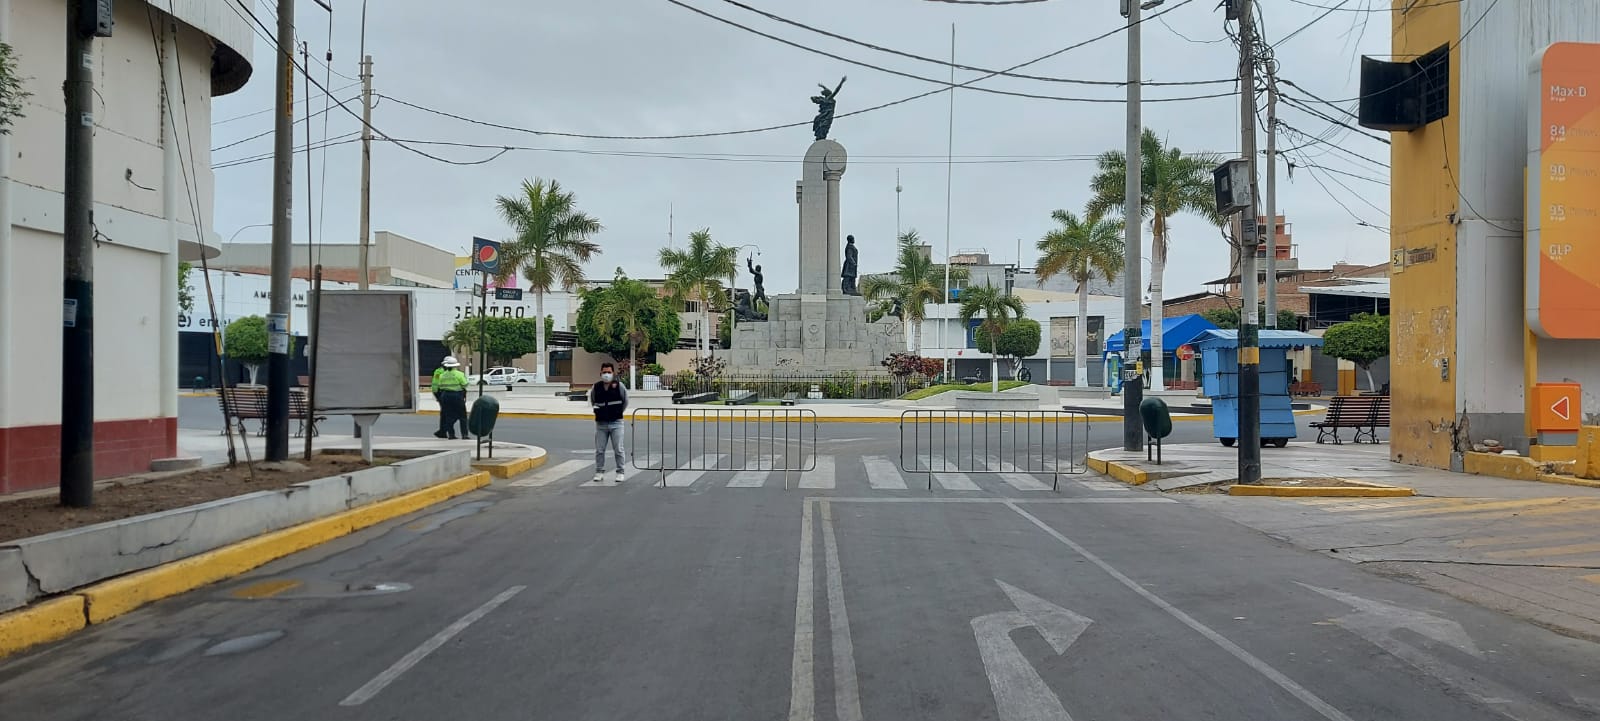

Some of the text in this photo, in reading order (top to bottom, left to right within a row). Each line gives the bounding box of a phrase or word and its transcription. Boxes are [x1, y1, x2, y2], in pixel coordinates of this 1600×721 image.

[1550, 124, 1566, 136] 84
[1550, 164, 1566, 175] 90
[1550, 204, 1565, 216] 95
[1550, 244, 1572, 255] GLP
[253, 290, 304, 301] AMEAN
